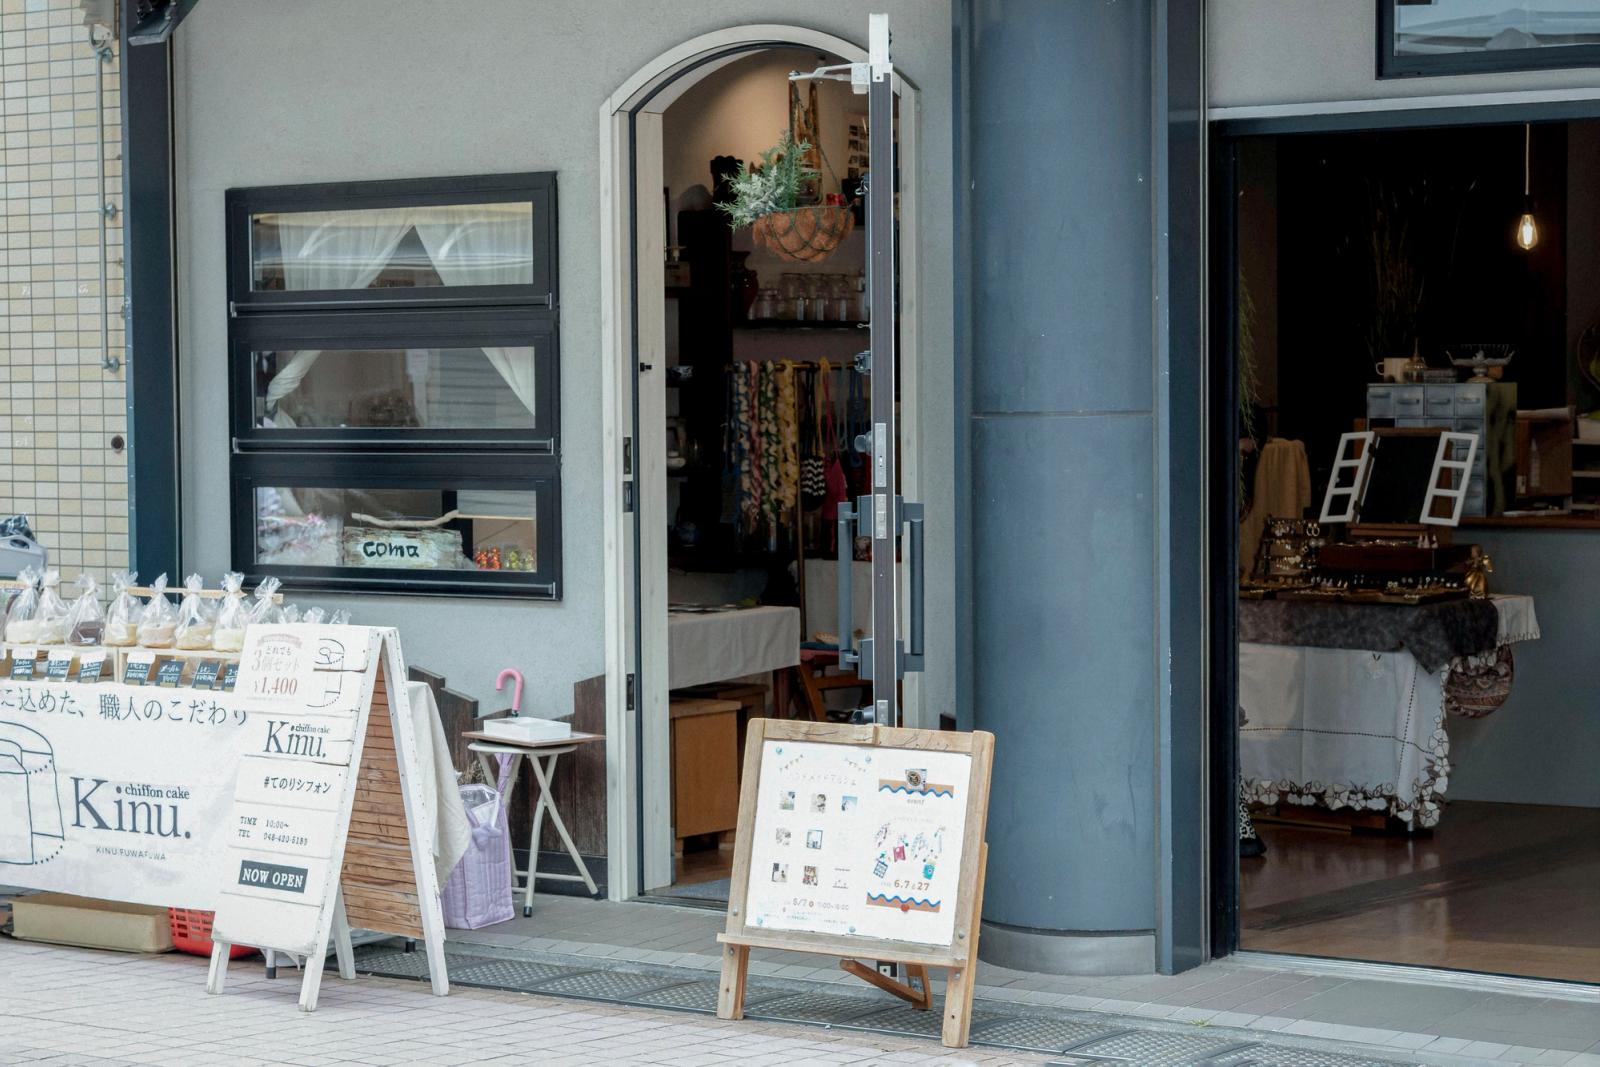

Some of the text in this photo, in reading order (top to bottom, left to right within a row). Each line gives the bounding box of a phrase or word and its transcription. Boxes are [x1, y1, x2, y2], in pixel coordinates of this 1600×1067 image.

[363, 541, 419, 557] coma
[124, 783, 190, 800] chiffon cake
[70, 776, 191, 840] Kinu.
[240, 816, 258, 826] TIME
[238, 829, 251, 838] TEL
[96, 846, 118, 855] KINU
[242, 868, 304, 889] NOW OPEN
